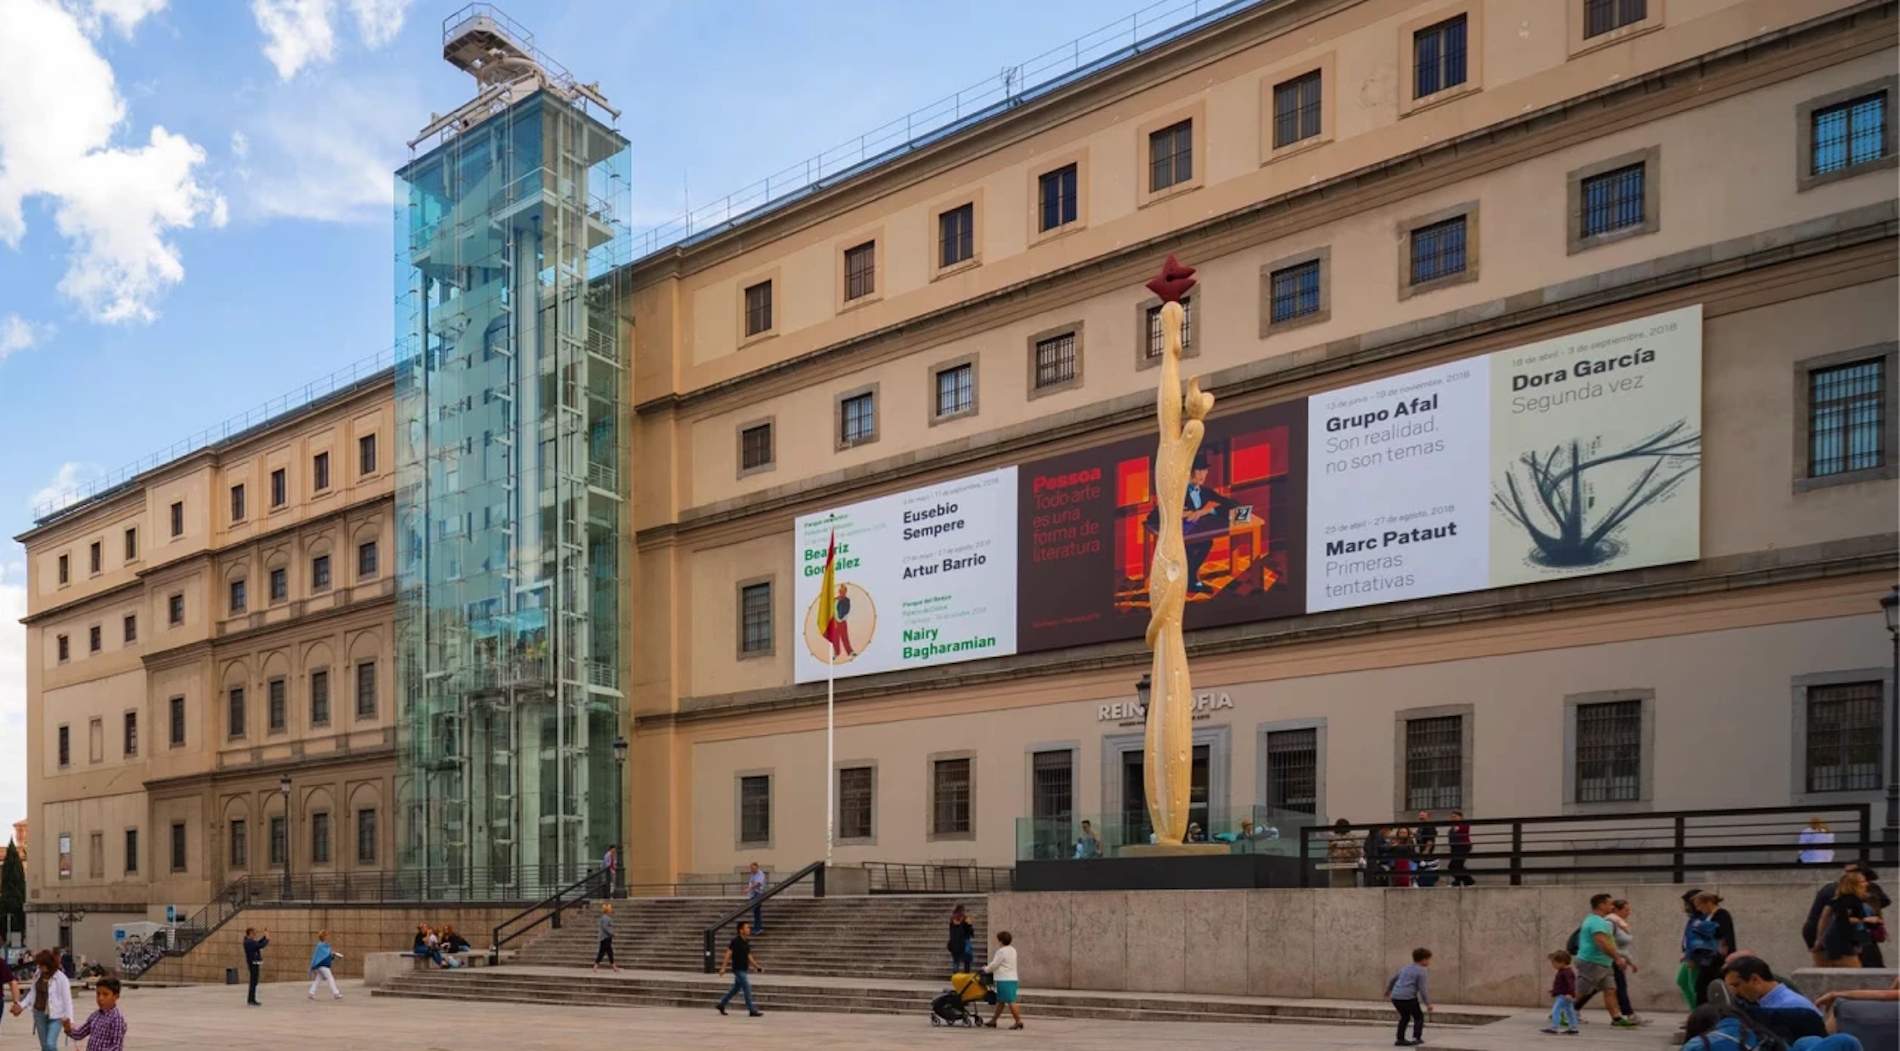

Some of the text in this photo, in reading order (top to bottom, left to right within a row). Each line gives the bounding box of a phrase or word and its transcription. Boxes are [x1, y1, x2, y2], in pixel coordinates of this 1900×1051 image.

[1649, 322, 1678, 338] 2018
[1512, 347, 1656, 392] Dora García
[1511, 374, 1645, 415] Segunda vez
[1326, 393, 1438, 432] Grupo Afal
[1326, 436, 1360, 454] Son
[1326, 437, 1446, 474] no son temas
[1033, 467, 1101, 493] Pessoa
[903, 502, 958, 524] Eusebio
[1033, 509, 1081, 528] es una
[1431, 504, 1455, 515] 2018
[903, 519, 965, 541] Sempere
[1080, 519, 1099, 535] de
[1326, 522, 1457, 556] Marc Pataut
[804, 543, 849, 561] Beariz
[903, 553, 986, 580] Artur Barrio
[1326, 554, 1403, 576] Primeras
[1326, 573, 1415, 598] tentativas
[903, 627, 938, 642] Nairy
[903, 636, 996, 659] Bagharamian
[1098, 702, 1145, 721] REIN
